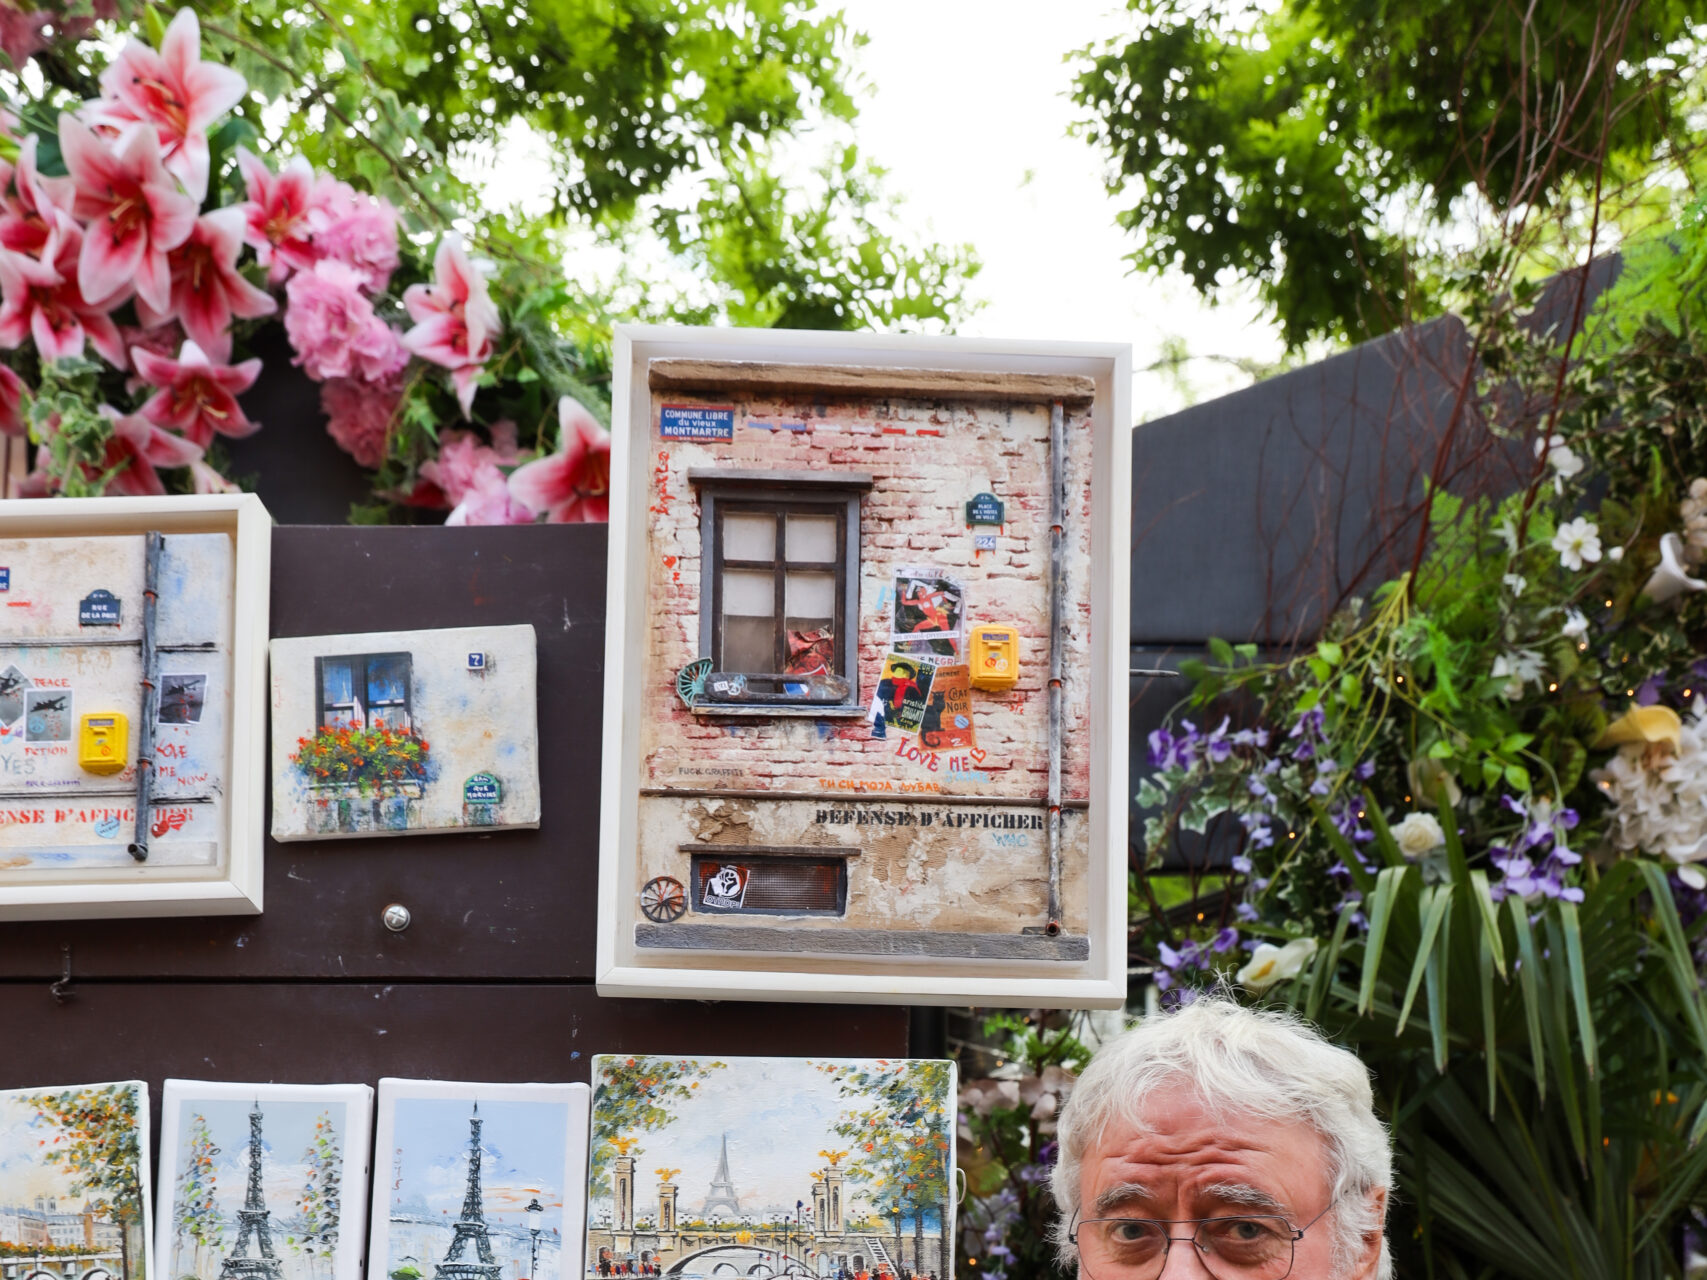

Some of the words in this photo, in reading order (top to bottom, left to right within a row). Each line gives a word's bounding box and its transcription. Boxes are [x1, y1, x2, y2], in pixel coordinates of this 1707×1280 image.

[664, 410, 703, 419] COMMUNE
[705, 412, 729, 420] LIBRE
[678, 419, 689, 427] du
[664, 426, 729, 437] MONTMARTRE
[946, 702, 968, 713] NOIR
[895, 736, 940, 772] LOVE
[950, 756, 969, 771] ME
